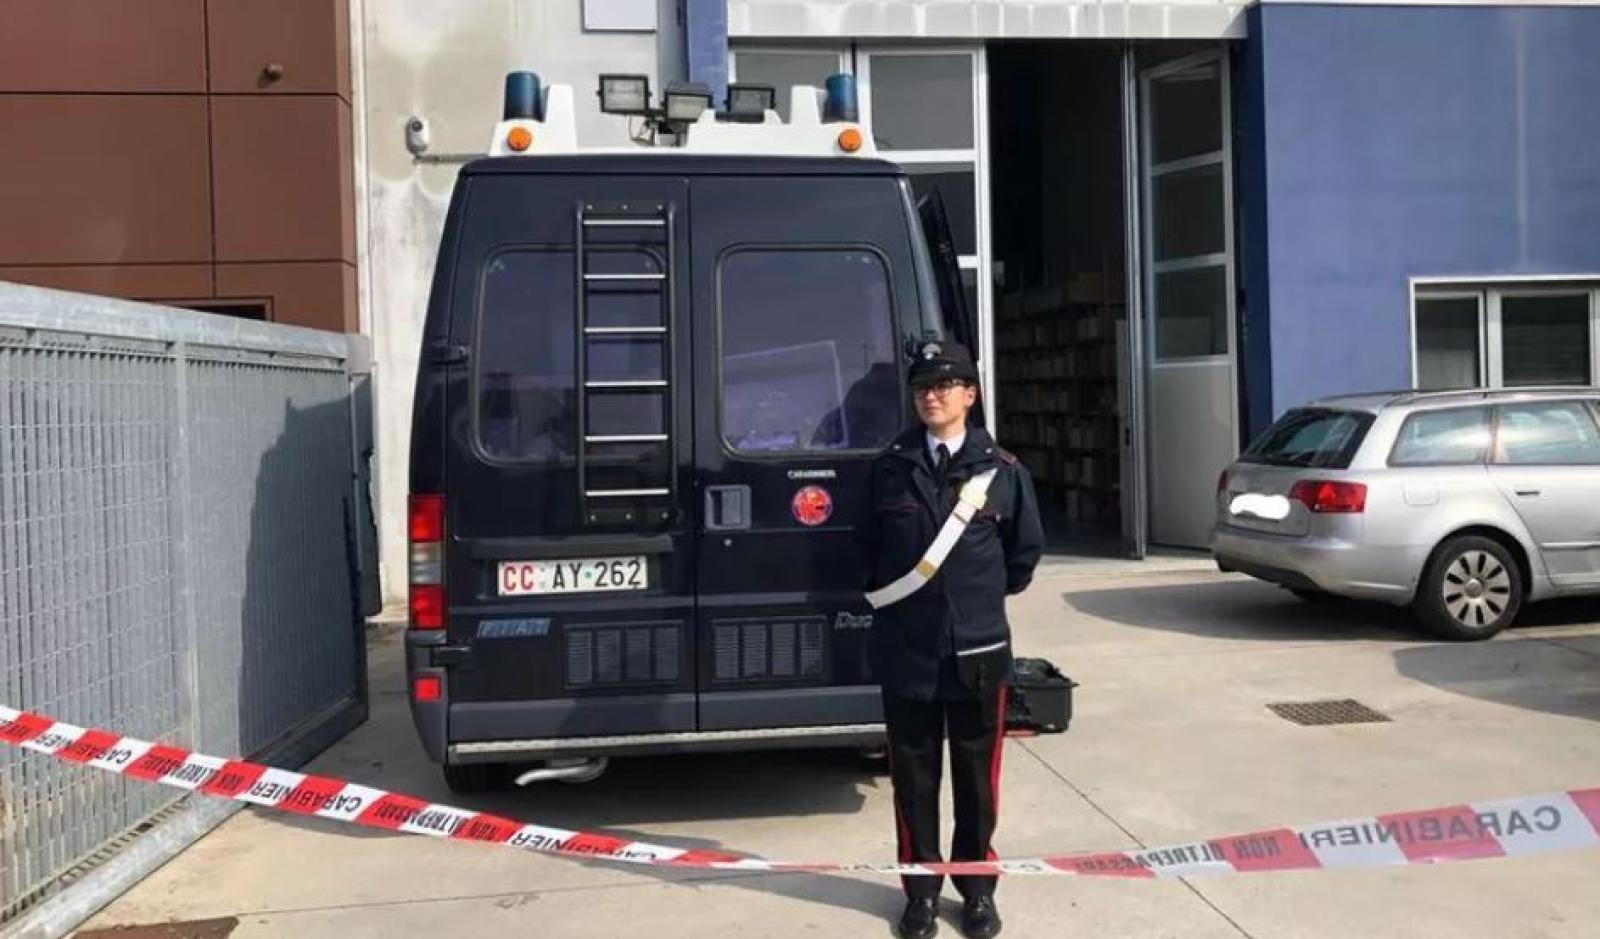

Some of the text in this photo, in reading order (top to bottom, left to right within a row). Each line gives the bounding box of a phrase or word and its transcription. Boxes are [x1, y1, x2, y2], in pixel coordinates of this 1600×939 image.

[503, 559, 641, 592] CC AY 262
